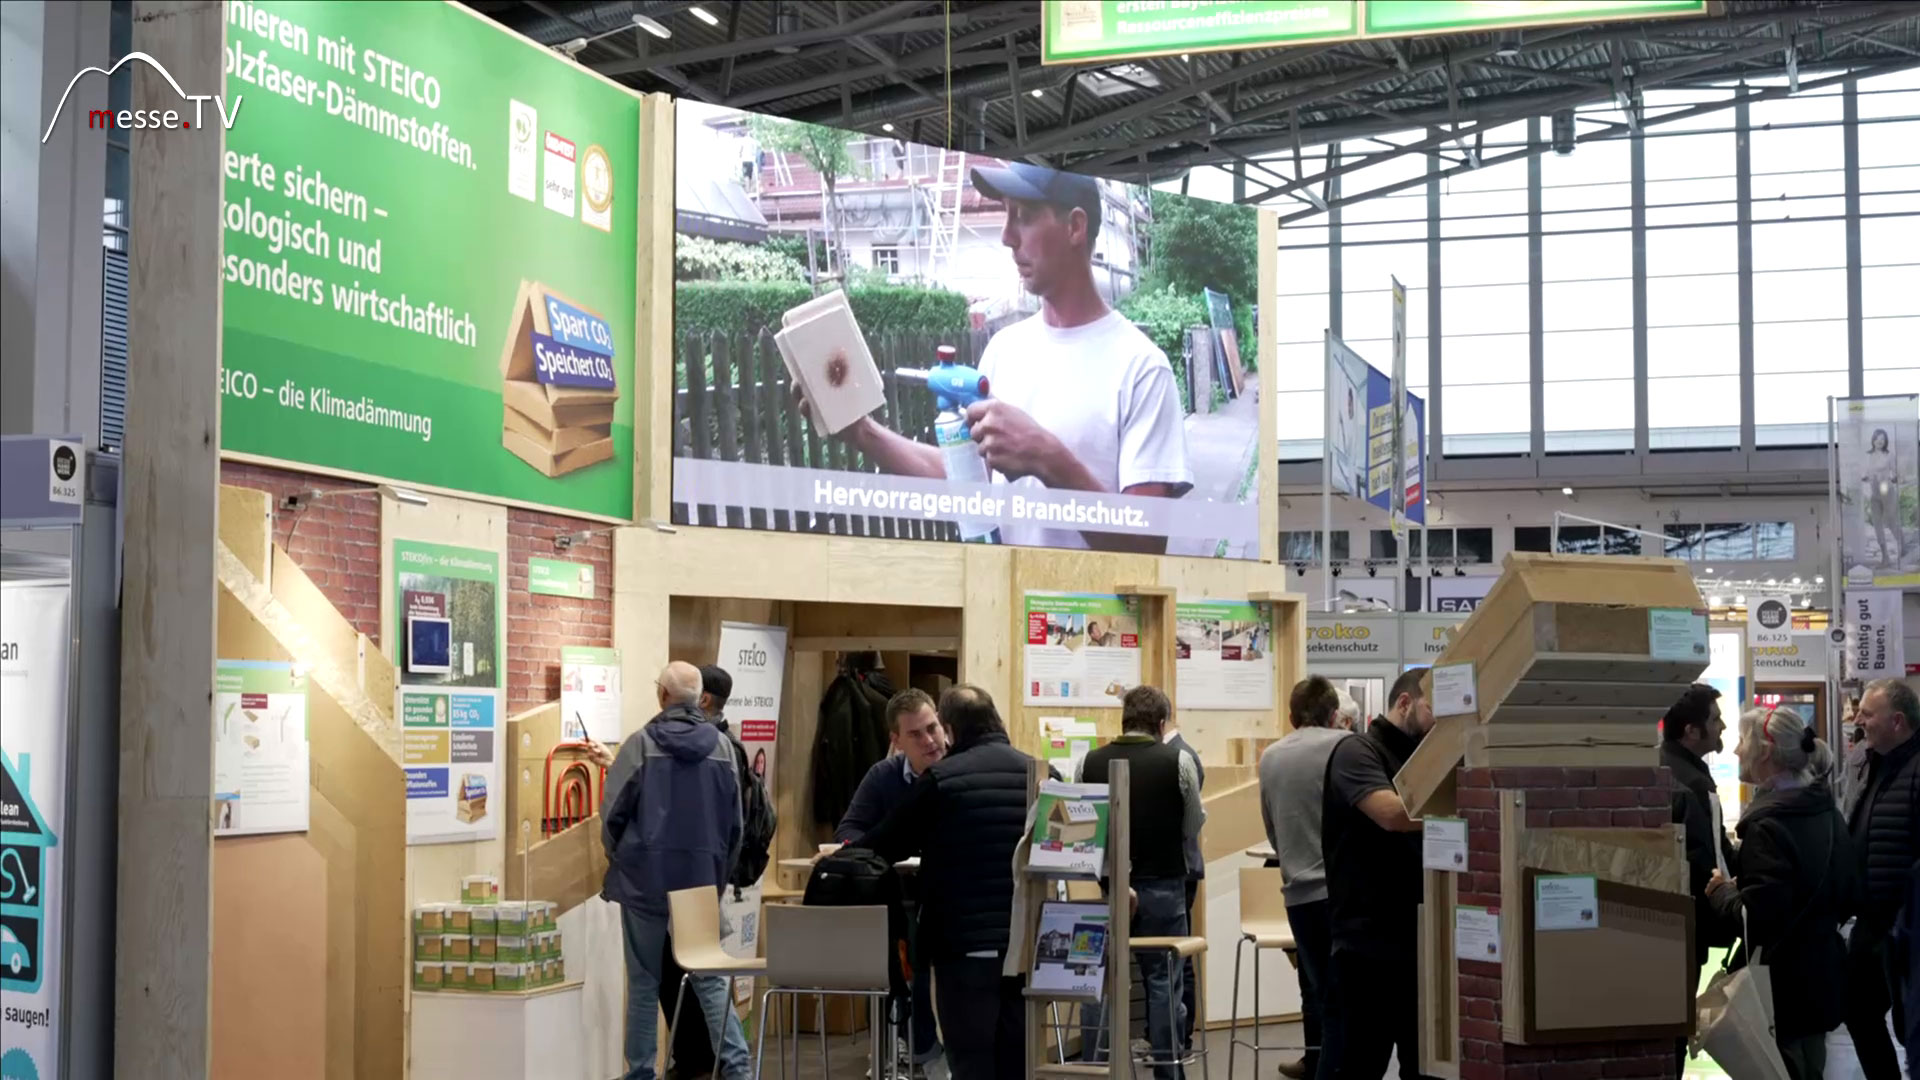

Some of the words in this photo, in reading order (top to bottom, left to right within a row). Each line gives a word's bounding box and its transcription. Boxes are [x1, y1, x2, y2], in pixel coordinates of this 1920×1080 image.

[226, 0, 308, 55] nieren
[317, 36, 355, 75] mit
[363, 49, 441, 109] STEICO
[224, 150, 275, 191] erte
[284, 165, 367, 221] sichern
[562, 187, 574, 200] gut
[338, 238, 381, 274] und
[222, 253, 324, 305] sonders
[331, 281, 476, 347] wirtschaftlich
[550, 301, 591, 341] Spart
[536, 342, 595, 381] Speichert
[279, 379, 305, 409] die
[310, 387, 432, 442] Klimadämmung
[813, 479, 1005, 517] Hervorragender
[1012, 497, 1150, 527] Brandschutz.
[1857, 598, 1872, 621] gut
[738, 643, 767, 667] STEICO
[1754, 658, 1806, 668] tenschutz
[1857, 624, 1872, 670] Richtig
[1874, 624, 1886, 670] Bauen.
[754, 696, 774, 708] STEICO
[5, 1007, 50, 1029] saugen!
